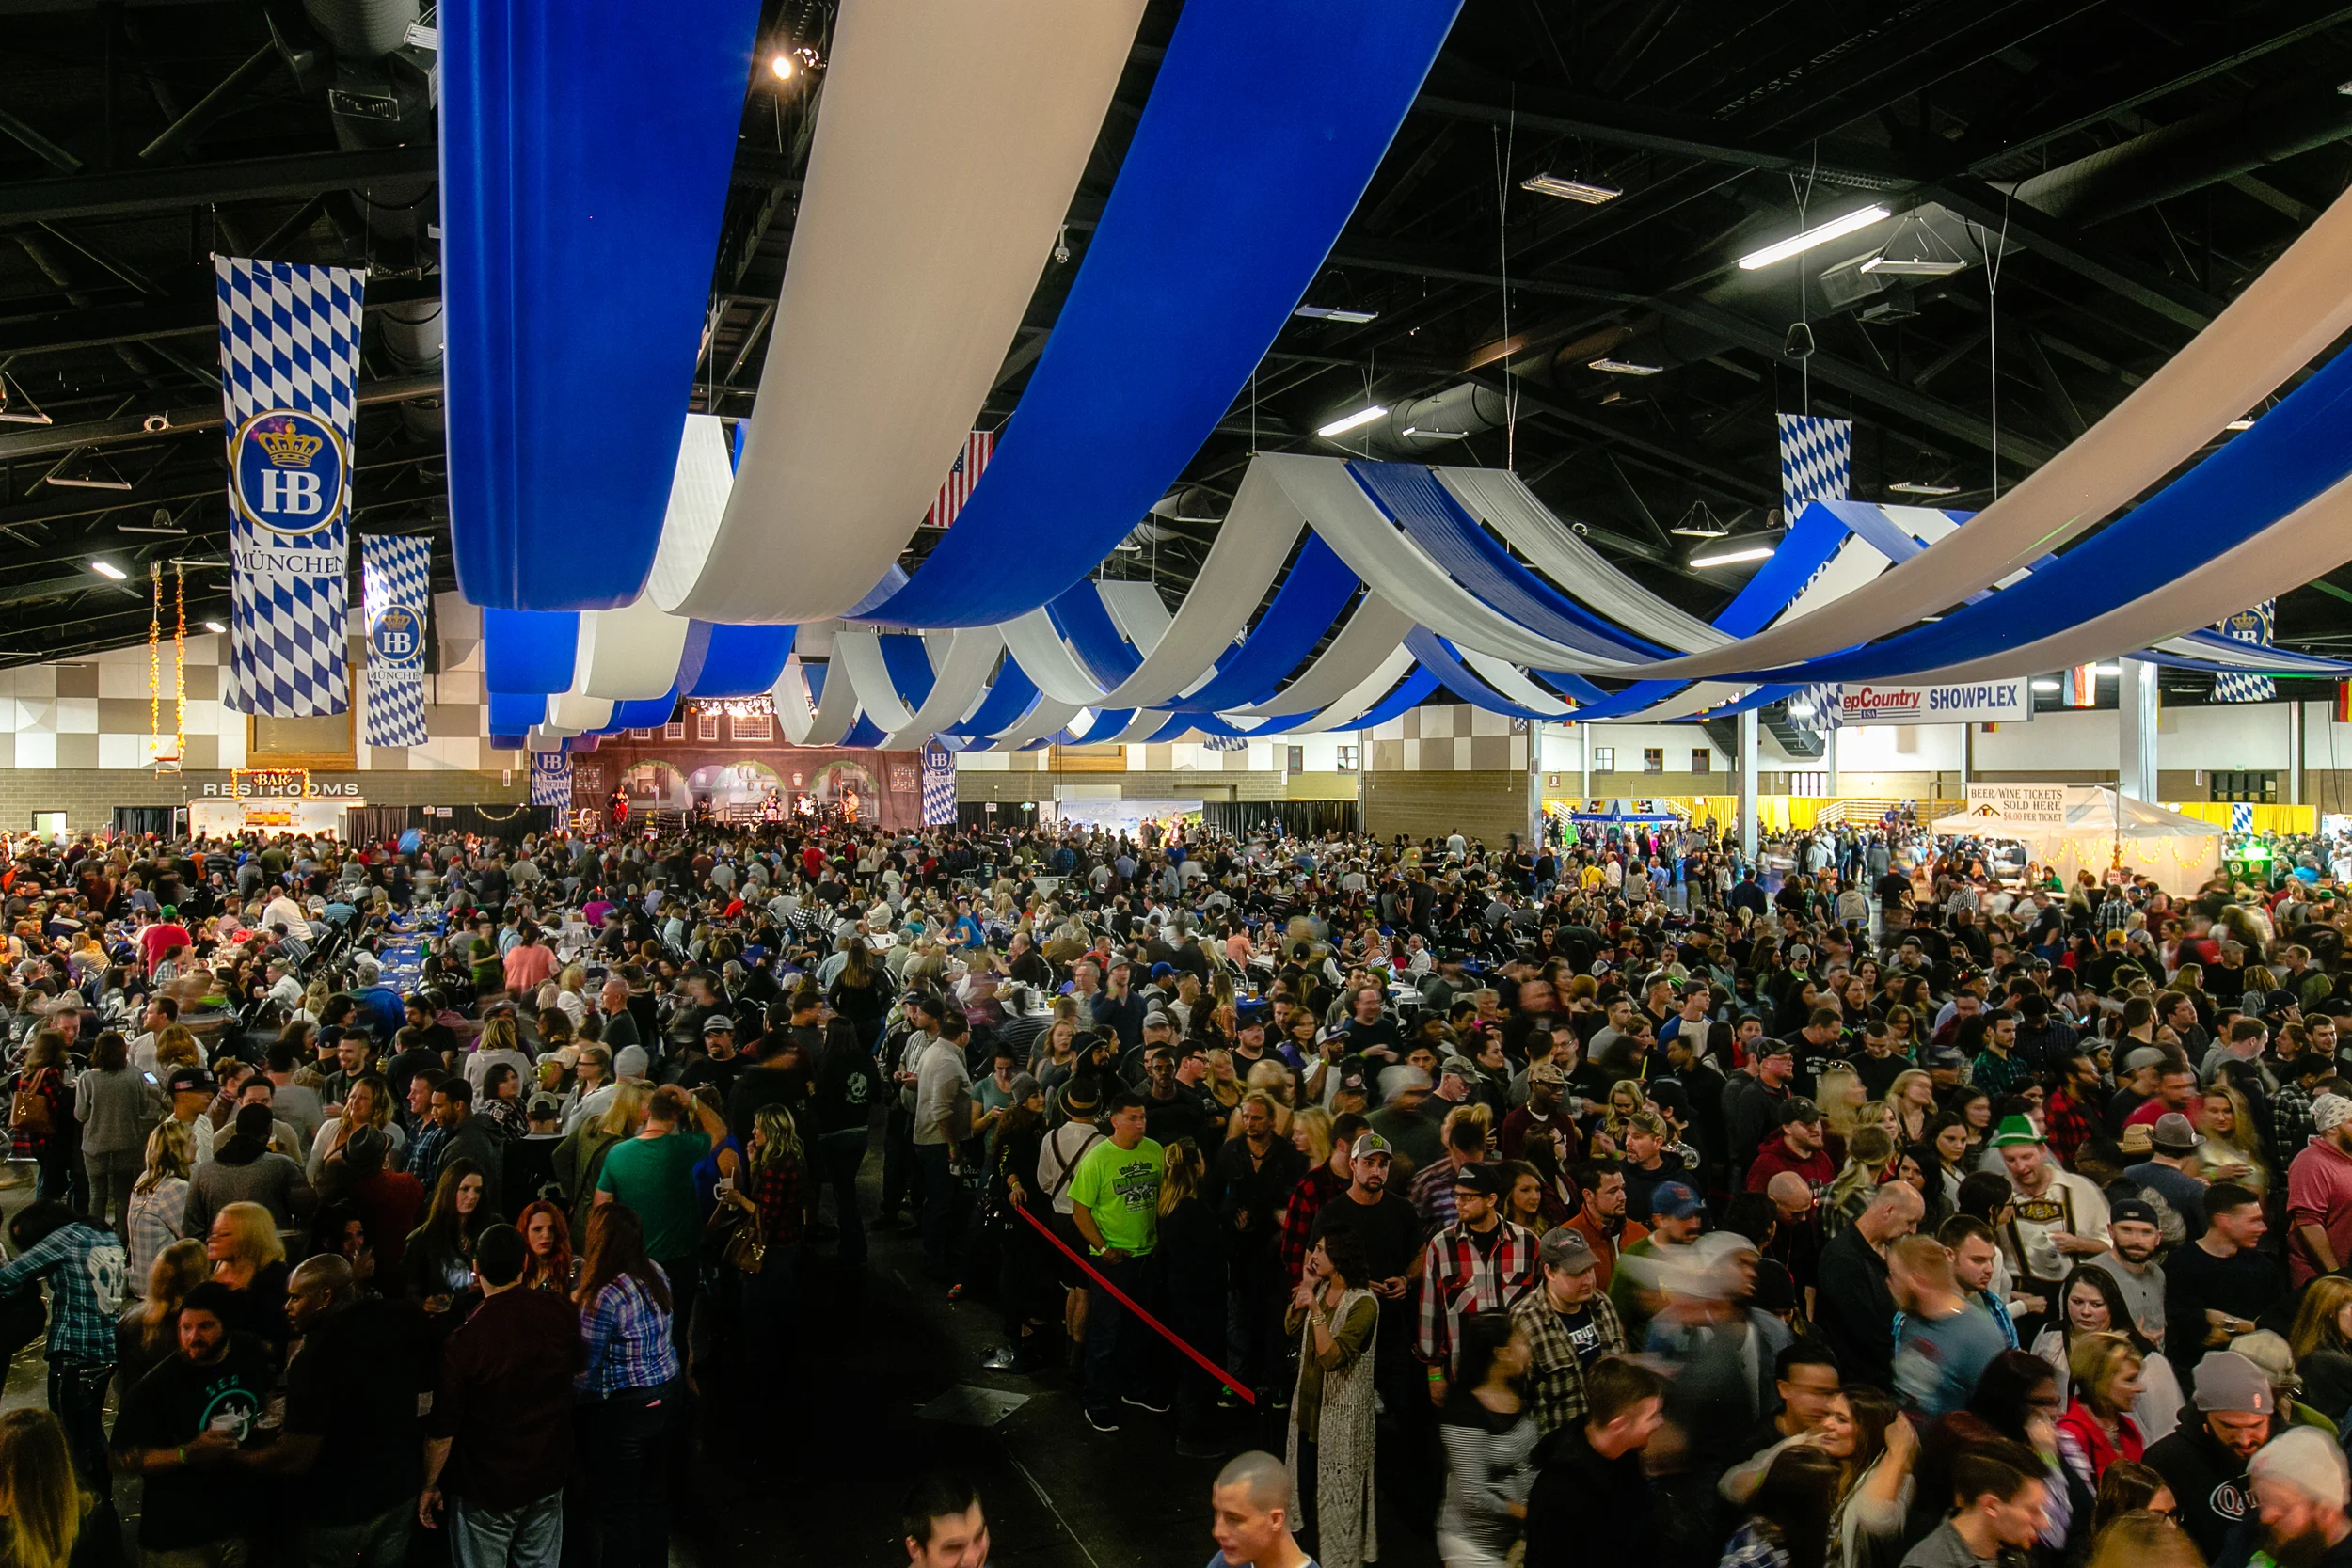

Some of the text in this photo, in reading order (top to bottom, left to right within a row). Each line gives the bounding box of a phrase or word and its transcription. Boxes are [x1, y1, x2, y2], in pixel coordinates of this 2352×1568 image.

[261, 469, 323, 515] HB
[383, 632, 411, 653] HB
[1930, 685, 2017, 710] SHOWPLEX
[1863, 710, 1876, 719] USA
[543, 754, 562, 769] HB
[931, 753, 947, 767] HB
[257, 773, 288, 785] BAR
[1971, 788, 2063, 800] BEER/WINE TICKETS
[2003, 800, 2061, 811] SOLD HERE
[2003, 812, 2062, 822] $6.00 PER TICKET
[984, 865, 993, 878] 3
